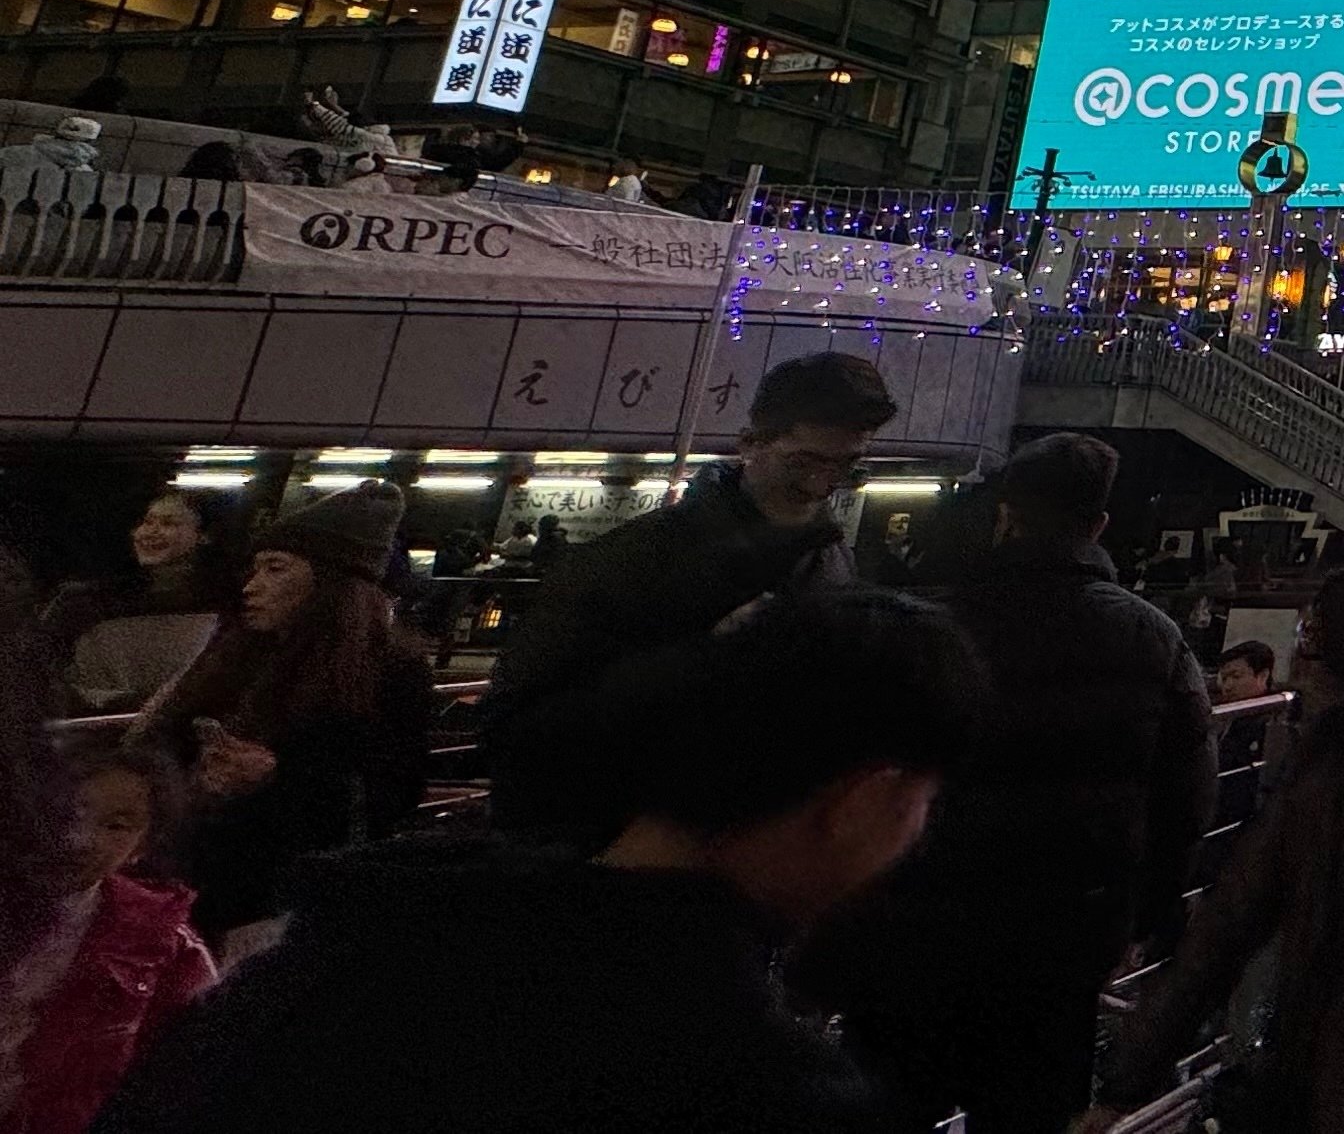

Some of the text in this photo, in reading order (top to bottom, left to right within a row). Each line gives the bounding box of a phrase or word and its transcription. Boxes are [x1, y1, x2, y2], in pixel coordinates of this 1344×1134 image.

[1109, 14, 1344, 33] アットコスメがプロデュースする
[1128, 34, 1321, 53] コスメのセレクトショップ
[1070, 184, 1141, 199] TSUTAYA
[299, 209, 515, 259] ORPEC
